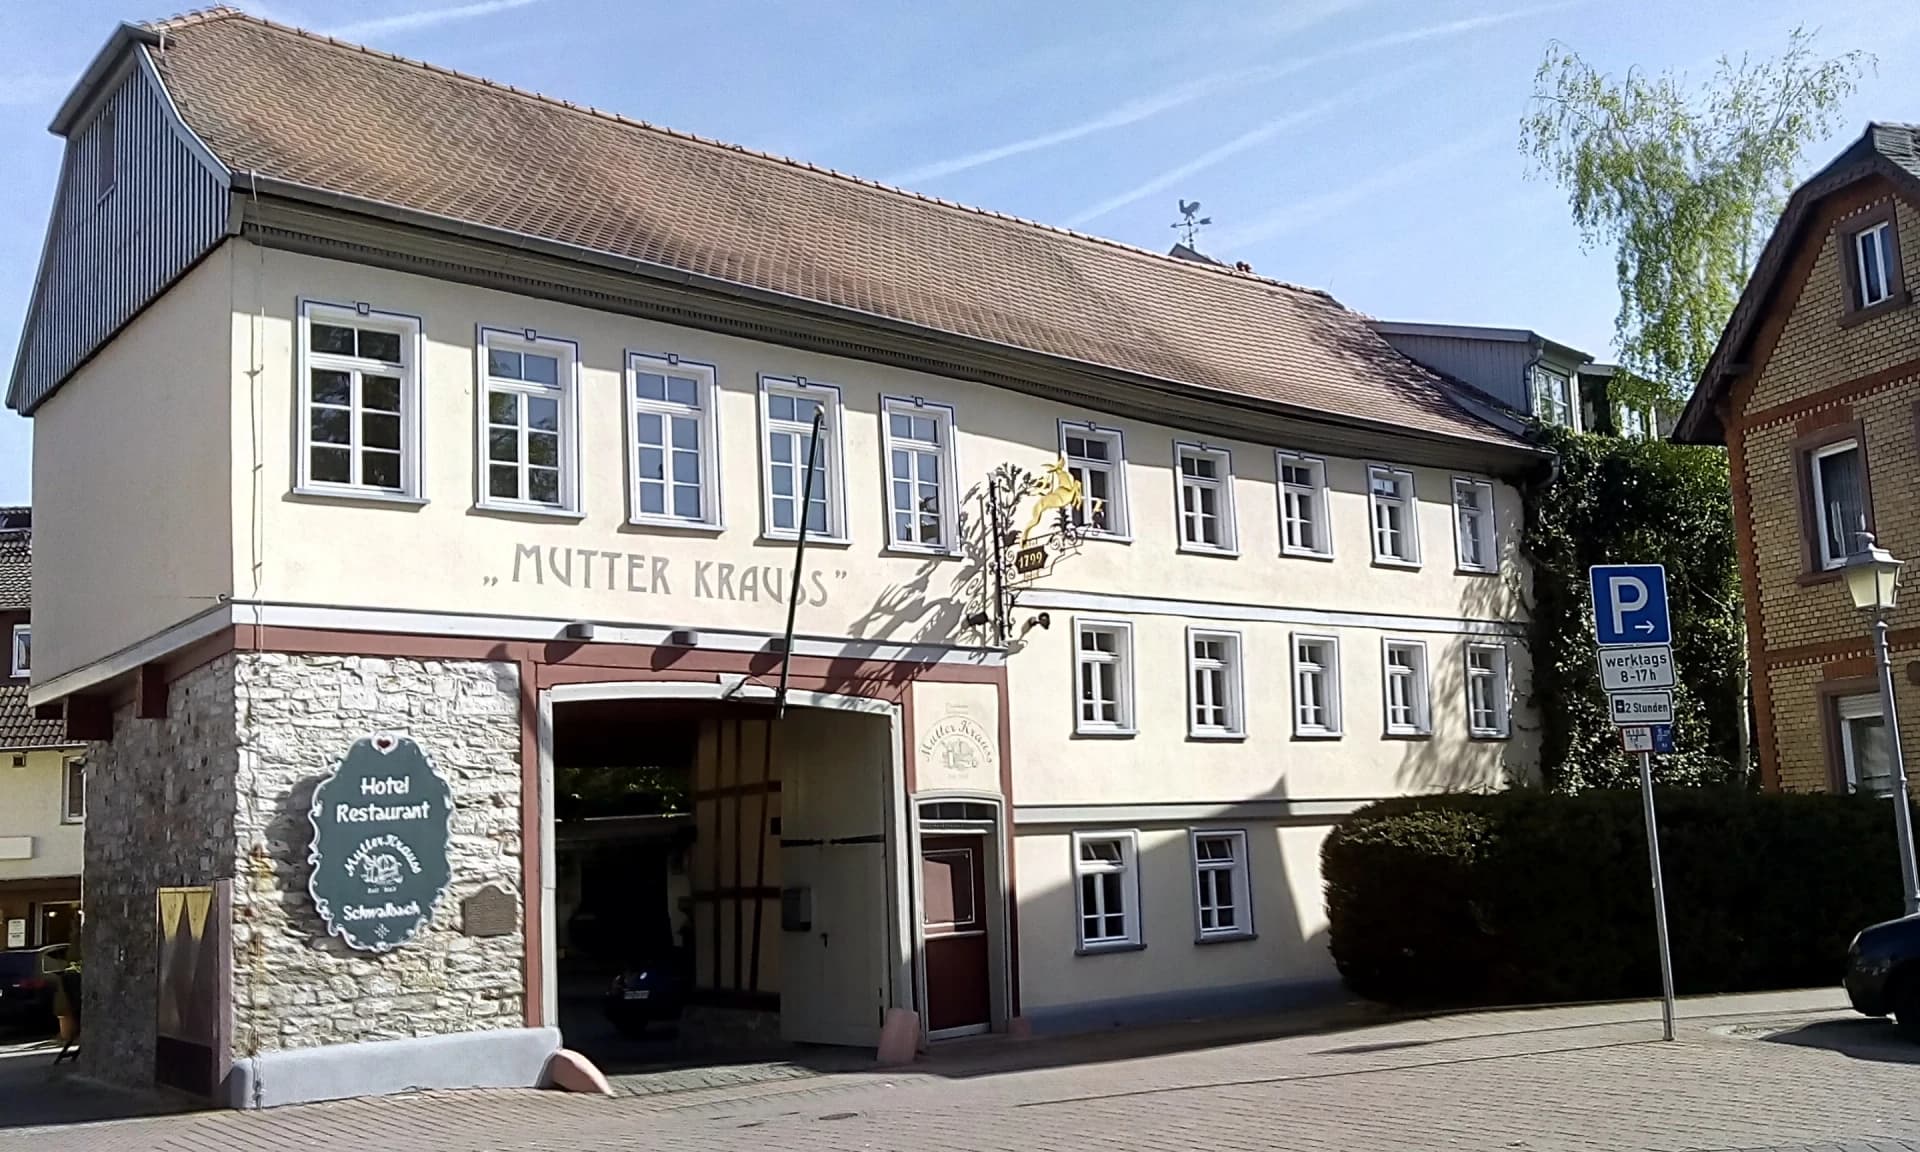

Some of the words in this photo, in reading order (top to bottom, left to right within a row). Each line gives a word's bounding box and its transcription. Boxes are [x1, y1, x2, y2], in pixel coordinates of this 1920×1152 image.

[1018, 551, 1043, 569] 1799
[1609, 576, 1648, 634] P
[1605, 654, 1667, 668] werktags
[1625, 702, 1632, 714] 2
[1633, 702, 1668, 713] Stunden
[360, 775, 410, 795] Hotel
[336, 800, 431, 823] Restaurant
[344, 836, 384, 877] Mutter
[343, 901, 422, 921] Schwalbach
